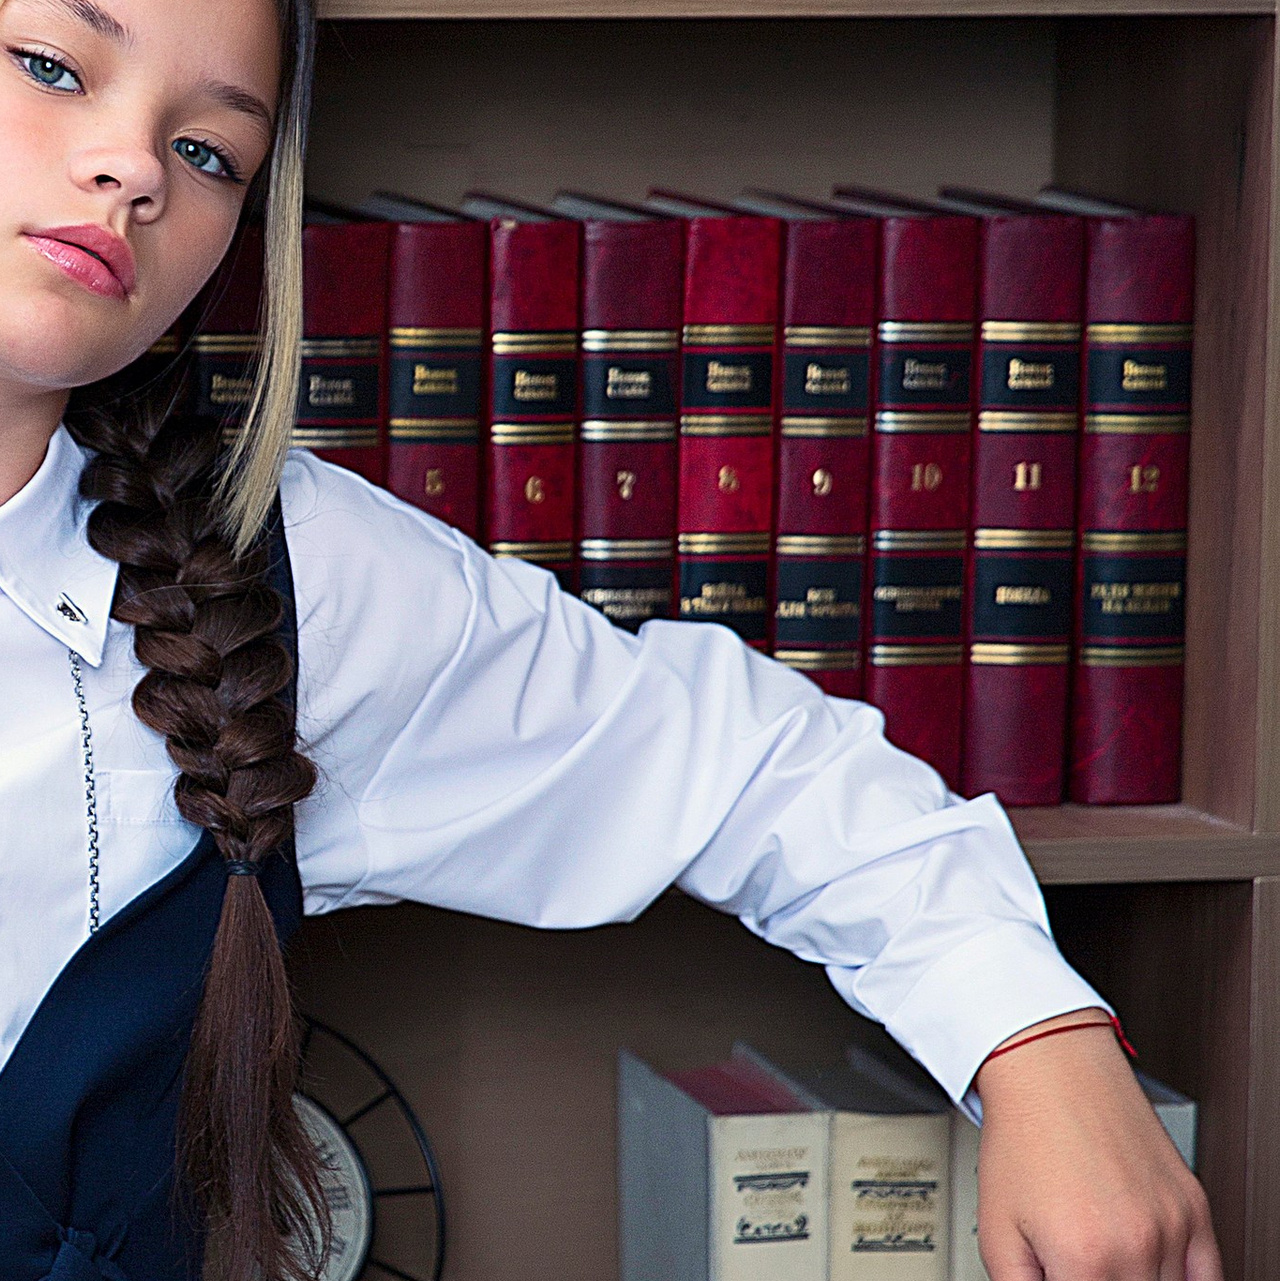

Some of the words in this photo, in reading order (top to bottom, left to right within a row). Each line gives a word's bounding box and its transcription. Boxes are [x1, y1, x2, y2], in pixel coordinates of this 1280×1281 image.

[616, 470, 637, 501] 7
[811, 467, 834, 498] 9
[910, 462, 944, 494] 10
[1012, 460, 1044, 493] 11
[1127, 463, 1162, 495] 12
